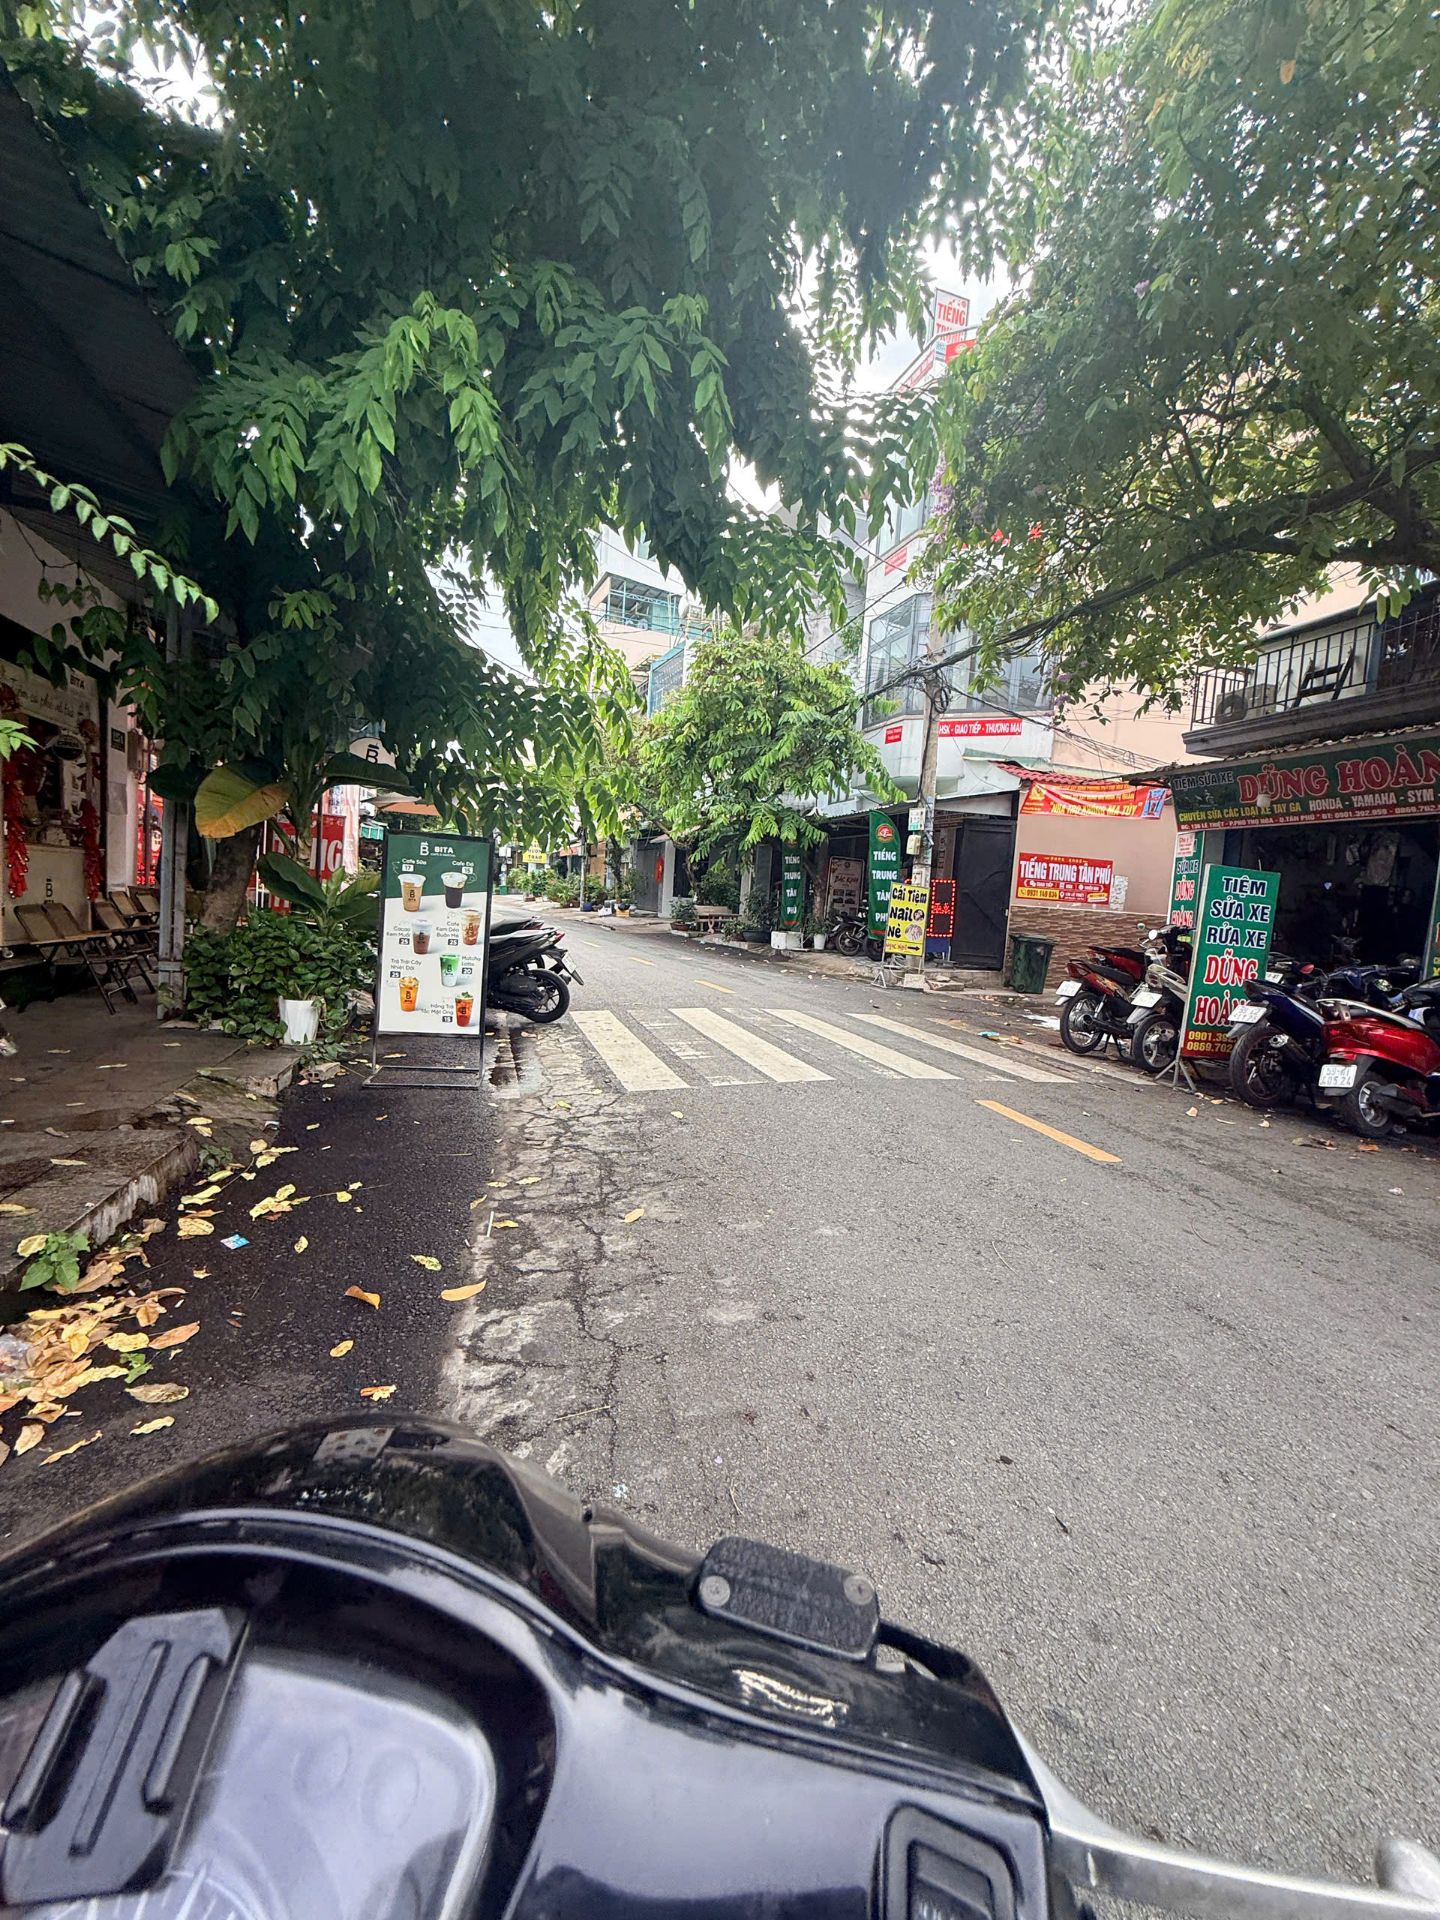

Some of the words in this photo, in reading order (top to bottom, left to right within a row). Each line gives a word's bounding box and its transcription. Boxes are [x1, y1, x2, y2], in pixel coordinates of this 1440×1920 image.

[938, 299, 965, 326] TIẾNG
[955, 725, 968, 734] GIAO
[969, 721, 981, 734] TIẾP
[1010, 722, 1022, 735] MẠI
[1174, 777, 1197, 791] TIỆM
[1219, 771, 1233, 785] XE
[1309, 798, 1343, 811] HONDA
[1351, 792, 1398, 808] YAMAHA
[1407, 788, 1435, 803] SYM
[1223, 806, 1239, 818] CÁC
[1240, 805, 1259, 819] LOẠI
[1261, 806, 1272, 815] XE
[1273, 804, 1287, 814] TAY
[1289, 802, 1302, 812] GA
[434, 846, 454, 854] BITA
[873, 848, 897, 862] TIẾNG
[785, 854, 800, 864] TIẾNG
[1190, 859, 1199, 873] XE
[784, 871, 800, 880] TRUNG
[872, 870, 898, 880] TRUNG
[1020, 856, 1047, 879] TIẾNG
[1048, 863, 1077, 882] TRUNG
[1078, 862, 1095, 884] TÂN
[1094, 865, 1112, 885] PHÚ
[1222, 875, 1267, 898] TIỆM
[892, 886, 906, 901] Cái
[908, 889, 928, 906] Tiệm
[890, 906, 913, 922] Nail
[1210, 896, 1245, 920] SỬA
[1248, 903, 1271, 923] XE
[887, 923, 902, 938] Nè
[1206, 922, 1240, 946] RỬA
[1243, 929, 1267, 948] XE
[1203, 948, 1258, 987] DŨNG
